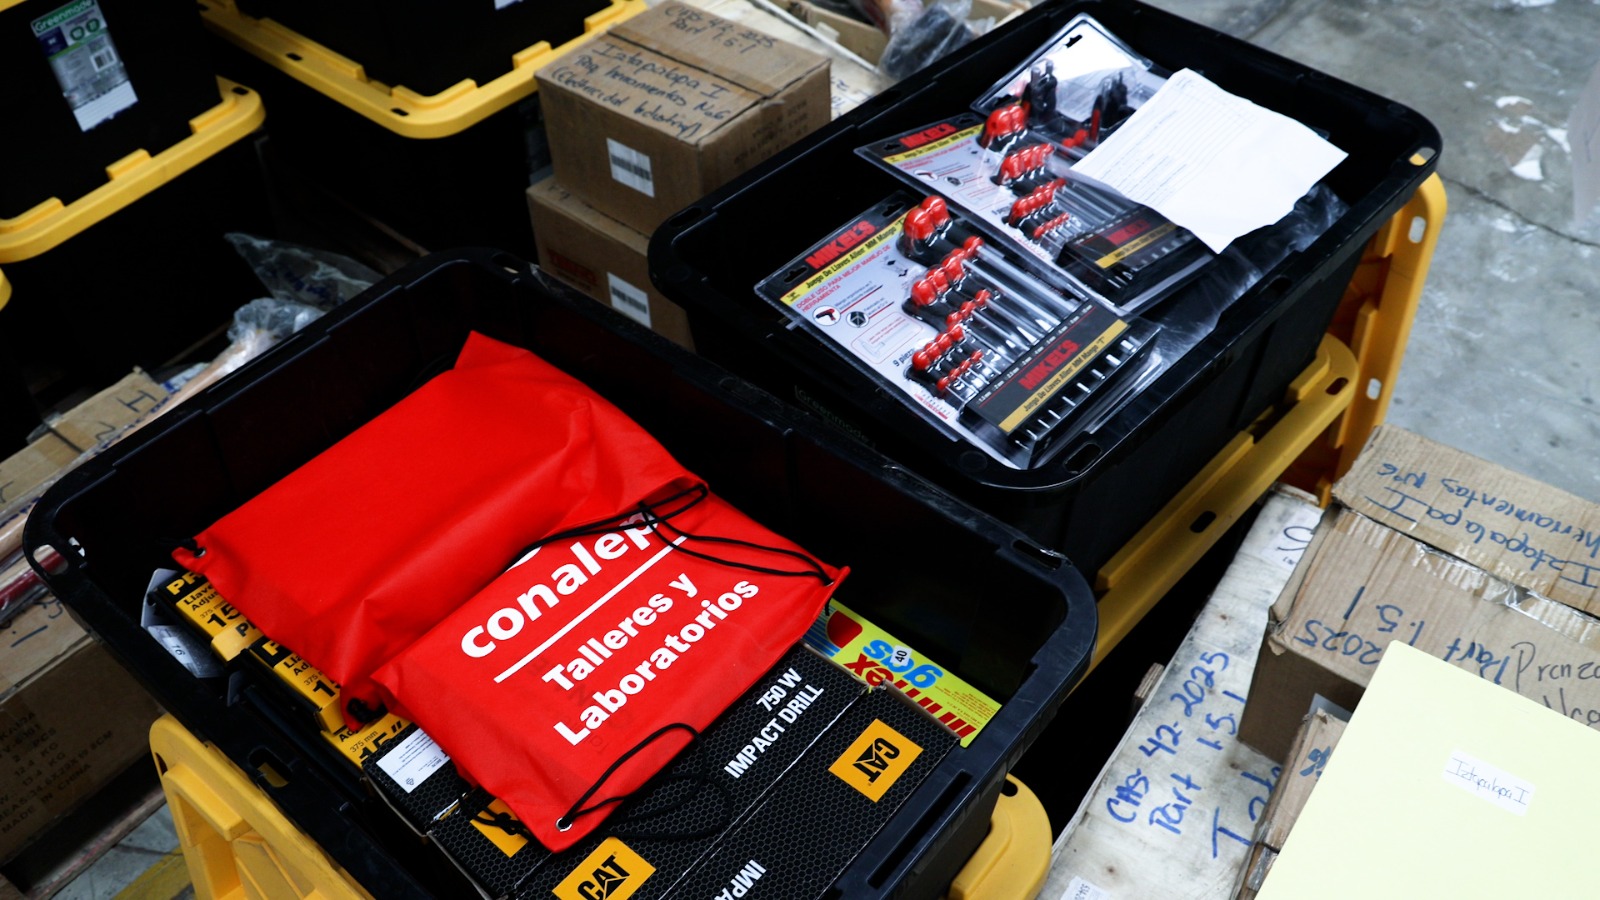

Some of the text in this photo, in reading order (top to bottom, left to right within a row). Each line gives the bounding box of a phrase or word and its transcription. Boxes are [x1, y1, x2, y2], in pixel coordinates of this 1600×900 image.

[34, 0, 96, 32] Greenmade
[795, 293, 818, 308] DOBLE
[815, 285, 829, 294] USO
[826, 275, 843, 287] PARA
[841, 264, 862, 277] MEJOR
[860, 250, 883, 265] MANEJO
[804, 274, 825, 288] Juego
[821, 268, 833, 276] De
[830, 257, 851, 271] Llaves
[864, 239, 878, 248] MM
[876, 226, 897, 241] Mango
[461, 510, 659, 659] conalep
[541, 572, 698, 691] Talleres y
[1294, 618, 1384, 666] 2025
[553, 579, 759, 746] Laboratorios
[893, 648, 908, 664] 40
[756, 668, 803, 713] 750 W
[41, 741, 59, 758] KG
[349, 741, 365, 754] 375
[363, 730, 379, 743] mm
[723, 716, 787, 780] IMPACT
[778, 684, 825, 726] DRILL
[48, 751, 67, 768] KG
[852, 737, 901, 784] CAT
[577, 854, 631, 900] CAT
